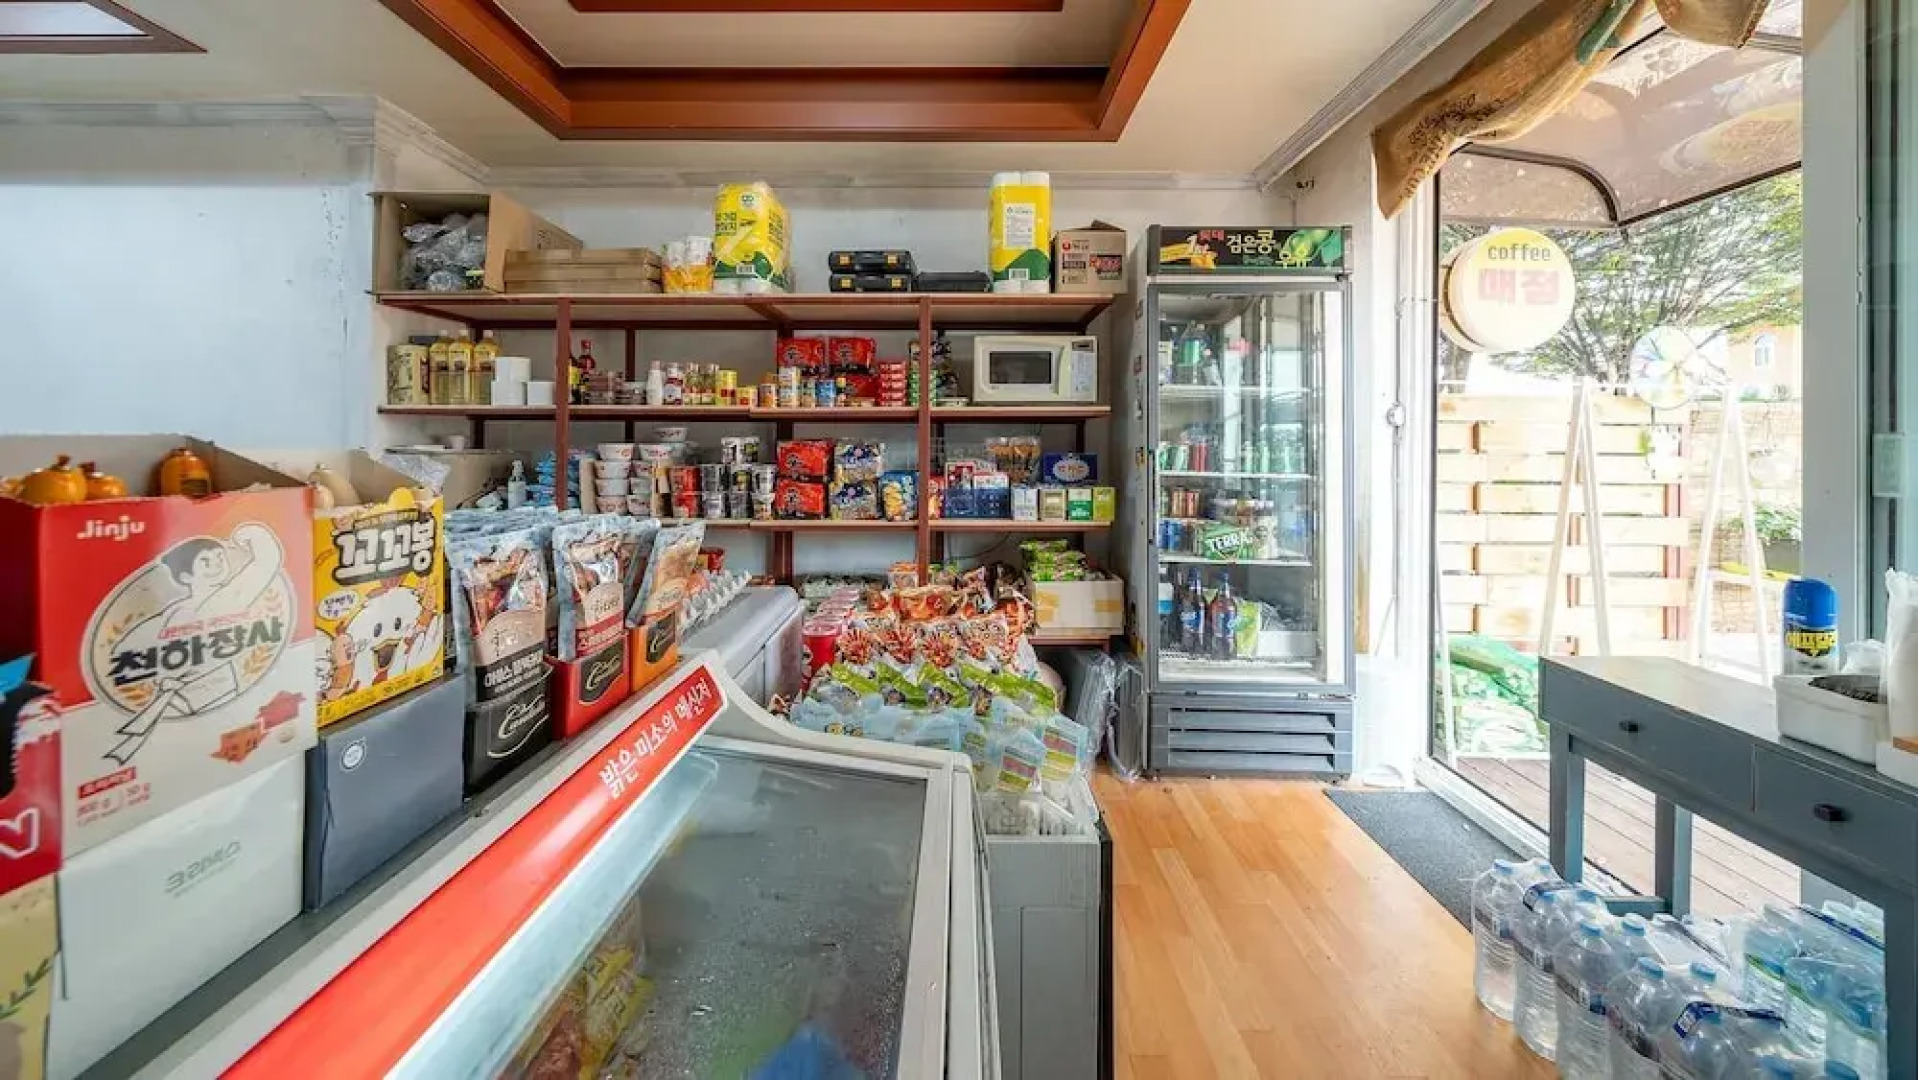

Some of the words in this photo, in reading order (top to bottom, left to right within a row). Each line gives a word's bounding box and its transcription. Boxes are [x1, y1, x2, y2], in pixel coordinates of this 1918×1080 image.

[1226, 230, 1276, 254] 검은콩
[1487, 243, 1551, 261] coffee
[76, 515, 145, 541] Jinju
[334, 518, 436, 580] 꼬꼬봉
[107, 616, 284, 685] 천하장사
[600, 752, 638, 798] 밝은
[636, 712, 678, 754] 미소의
